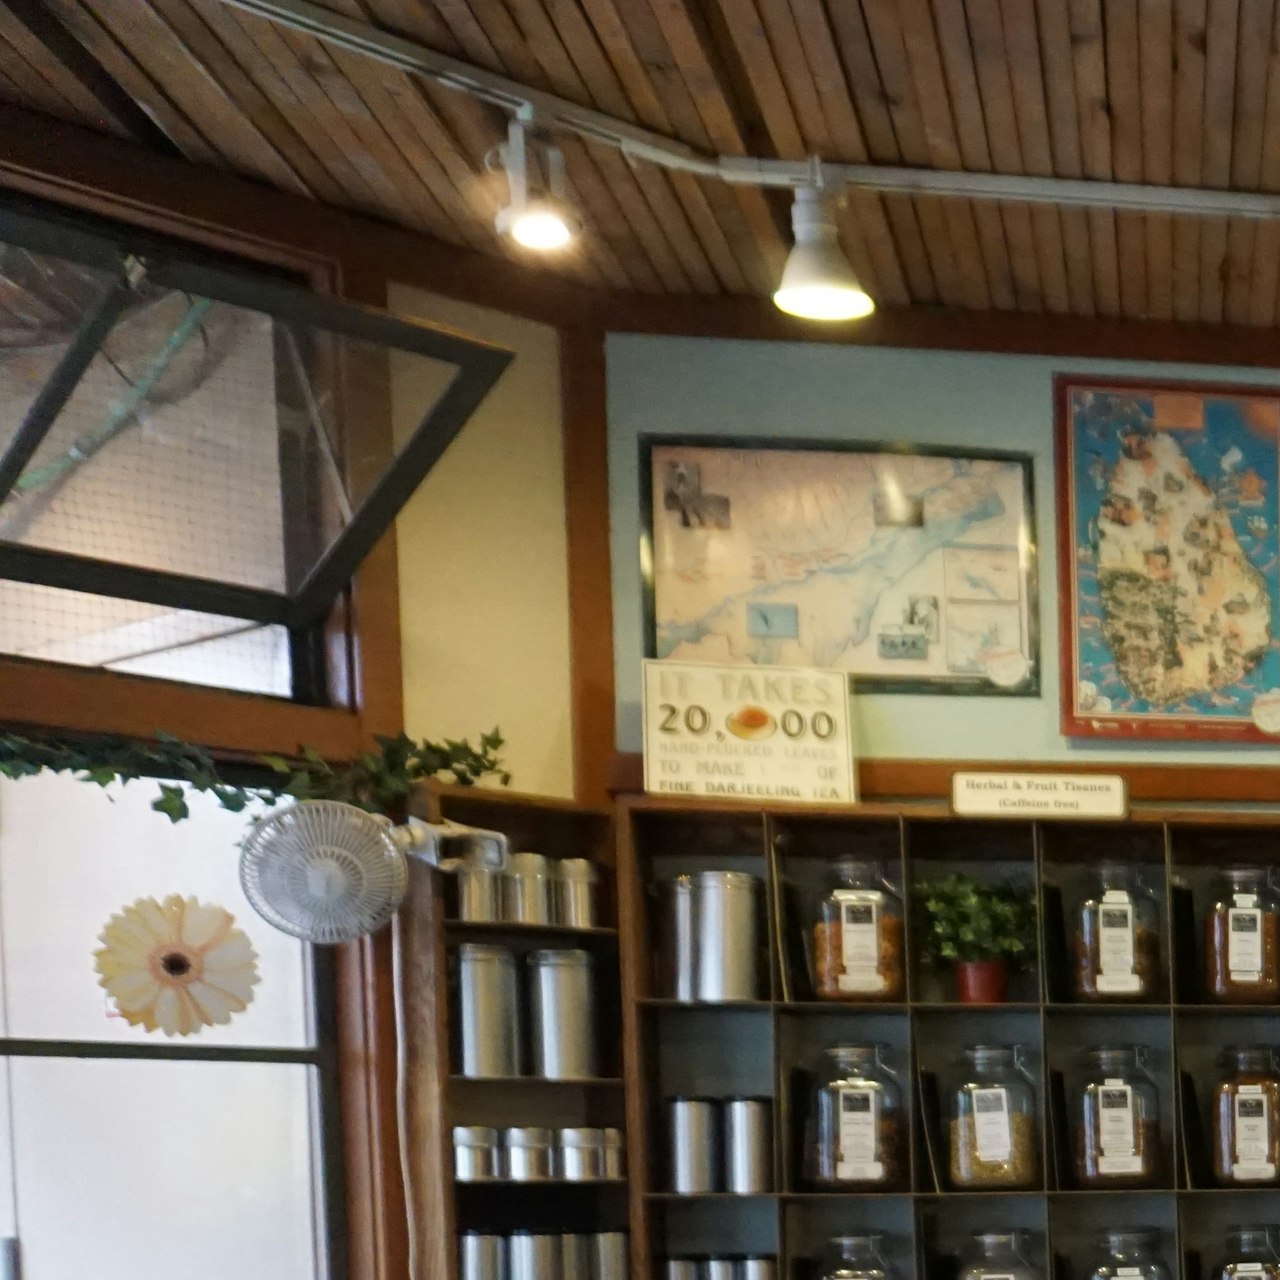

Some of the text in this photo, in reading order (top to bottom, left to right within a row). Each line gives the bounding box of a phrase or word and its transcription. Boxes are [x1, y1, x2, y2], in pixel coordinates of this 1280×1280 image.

[658, 671, 832, 705] IT TAKES
[658, 741, 838, 761] HAND-PLUCKED LEAVES
[659, 759, 681, 775] TO
[696, 760, 745, 776] MAKE
[817, 765, 838, 781] OF
[659, 780, 840, 800] FINE DARJEELING TEA
[965, 779, 1112, 792] Herbal & Fruit Tisanes
[998, 798, 1080, 810] (Caffeine free)
